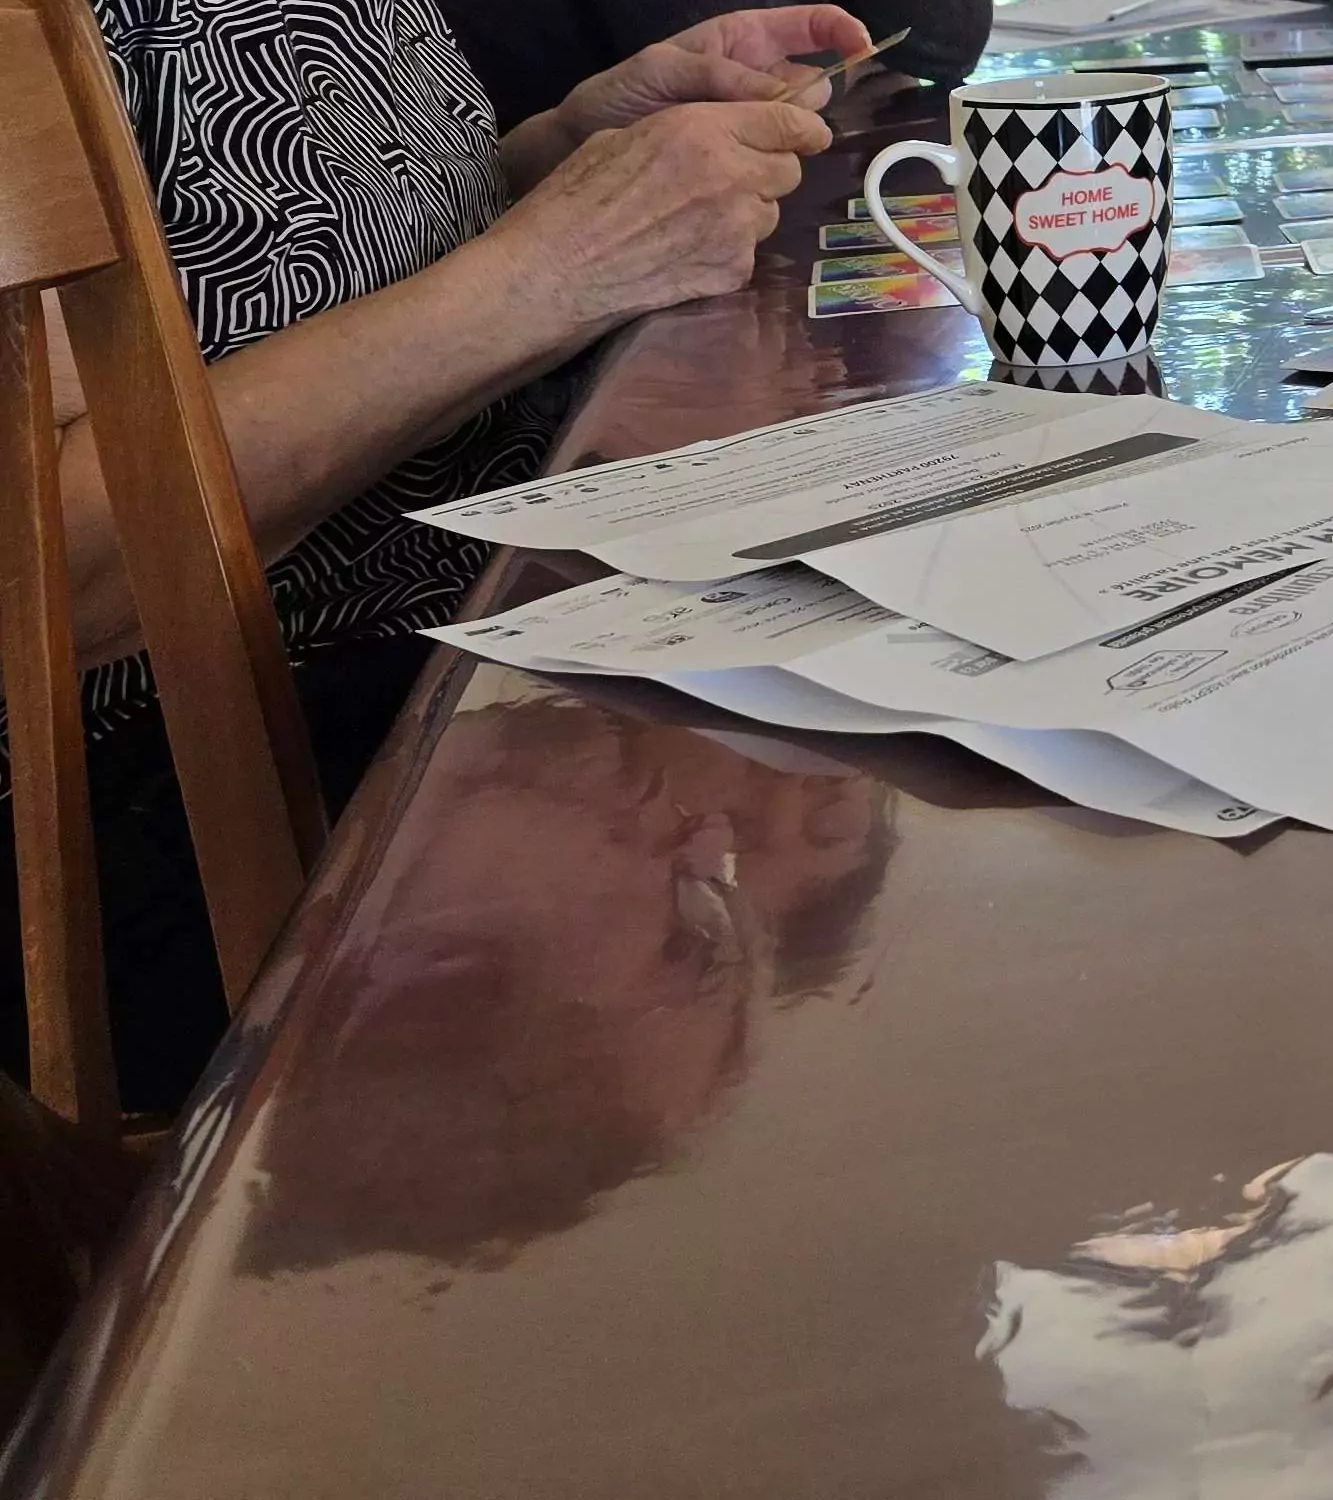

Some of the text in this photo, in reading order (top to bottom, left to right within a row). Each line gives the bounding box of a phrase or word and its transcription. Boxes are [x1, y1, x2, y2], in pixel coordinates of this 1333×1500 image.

[1061, 186, 1113, 206] HOME
[1028, 202, 1139, 230] SWEET HOME
[920, 454, 960, 468] 79200
[842, 464, 918, 490] PARTHENAY
[1180, 556, 1210, 568] une
[1212, 544, 1242, 559] pas
[1112, 564, 1178, 592] fatalité
[1120, 541, 1314, 602] MÉMOIRE
